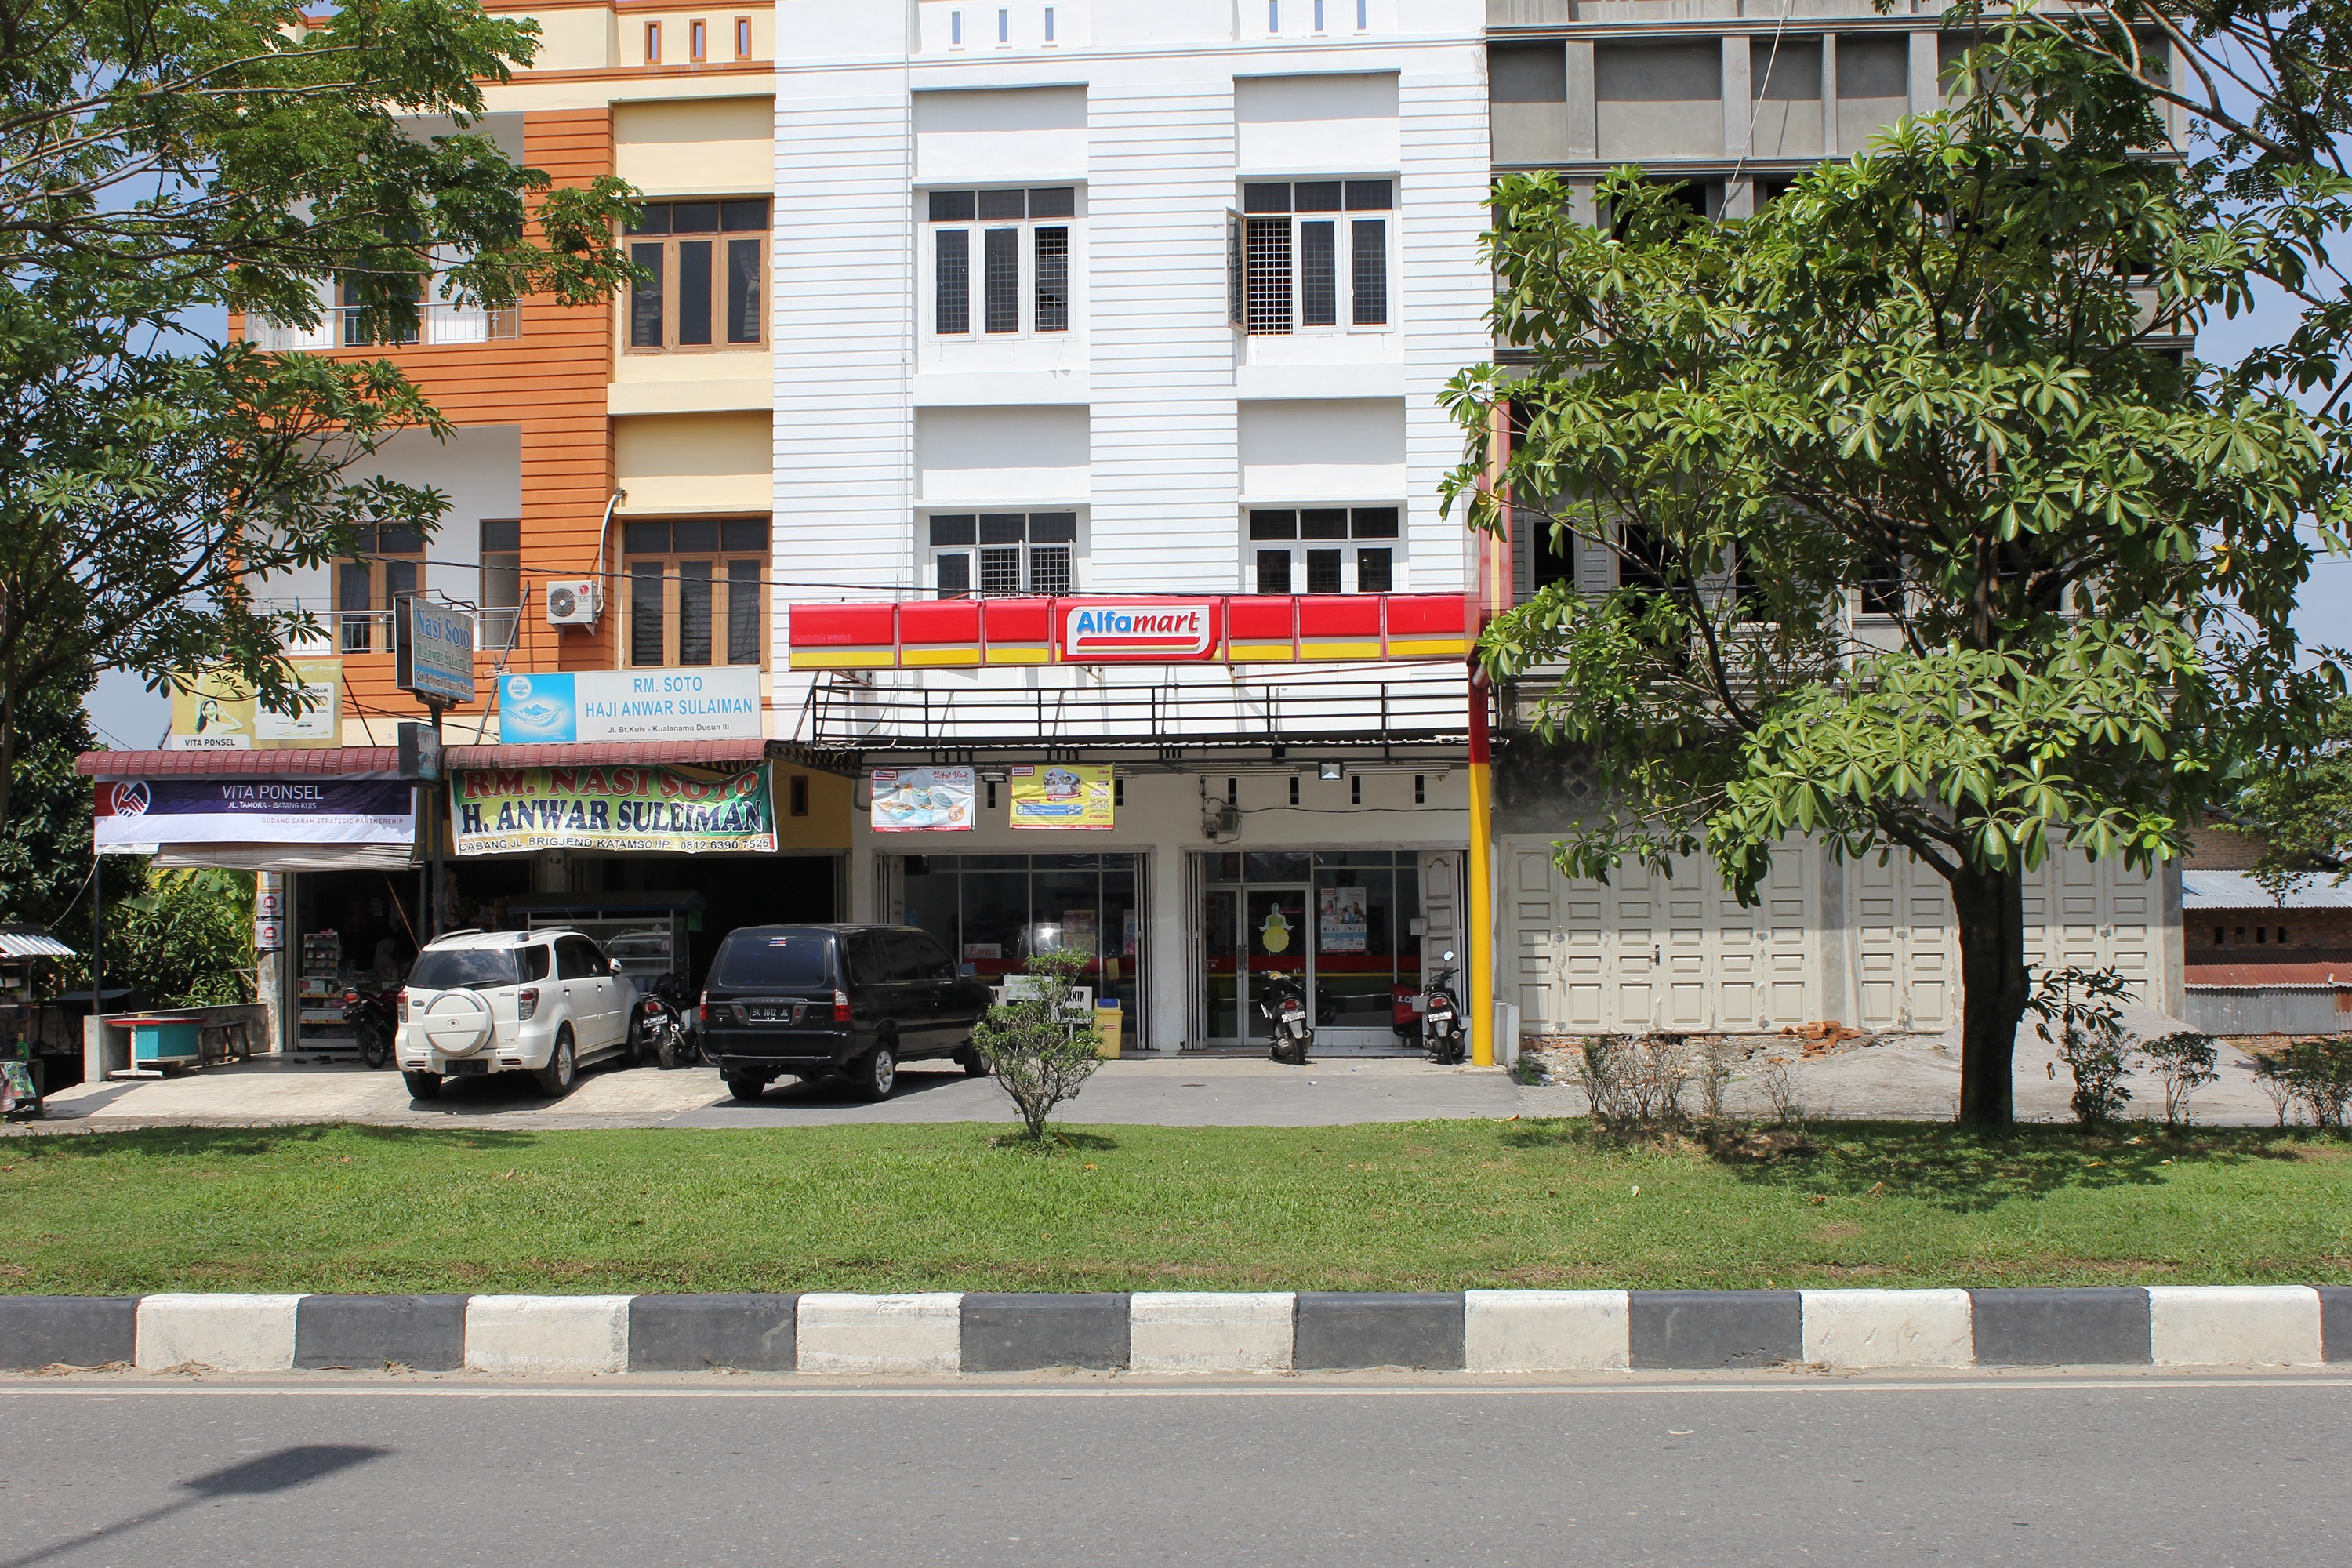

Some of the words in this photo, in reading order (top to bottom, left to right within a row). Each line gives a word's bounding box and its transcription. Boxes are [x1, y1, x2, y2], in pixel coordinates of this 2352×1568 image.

[416, 608, 442, 641] Nasi
[445, 617, 470, 650] Soto
[1076, 611, 1200, 633] Alfamart
[633, 677, 659, 693] RM.
[664, 676, 703, 692] SOTO
[586, 702, 618, 717] HAJI
[622, 700, 674, 717] ANWAR
[679, 698, 753, 715] SULAIMAN
[652, 724, 695, 732] Kualanamu
[222, 786, 255, 800] VITA
[260, 785, 324, 800] PONSEL
[463, 768, 536, 798] RM.
[547, 768, 651, 797] NASI
[659, 770, 760, 801] SOTO
[462, 801, 489, 834] H.
[496, 799, 611, 833] ANWAR
[617, 799, 764, 833] SULEIMAN
[459, 840, 507, 852] CABANG
[510, 837, 526, 848] JL.
[528, 837, 593, 848] BRIGJEND
[597, 838, 653, 849] KATAMSO
[655, 839, 670, 849] HP
[681, 840, 706, 850] 0812
[710, 840, 739, 849] 6390
[742, 838, 770, 849] 7525
[969, 946, 996, 956] Beras
[752, 1008, 760, 1017] BK
[764, 1008, 777, 1017] 1612
[780, 1008, 789, 1017] JK
